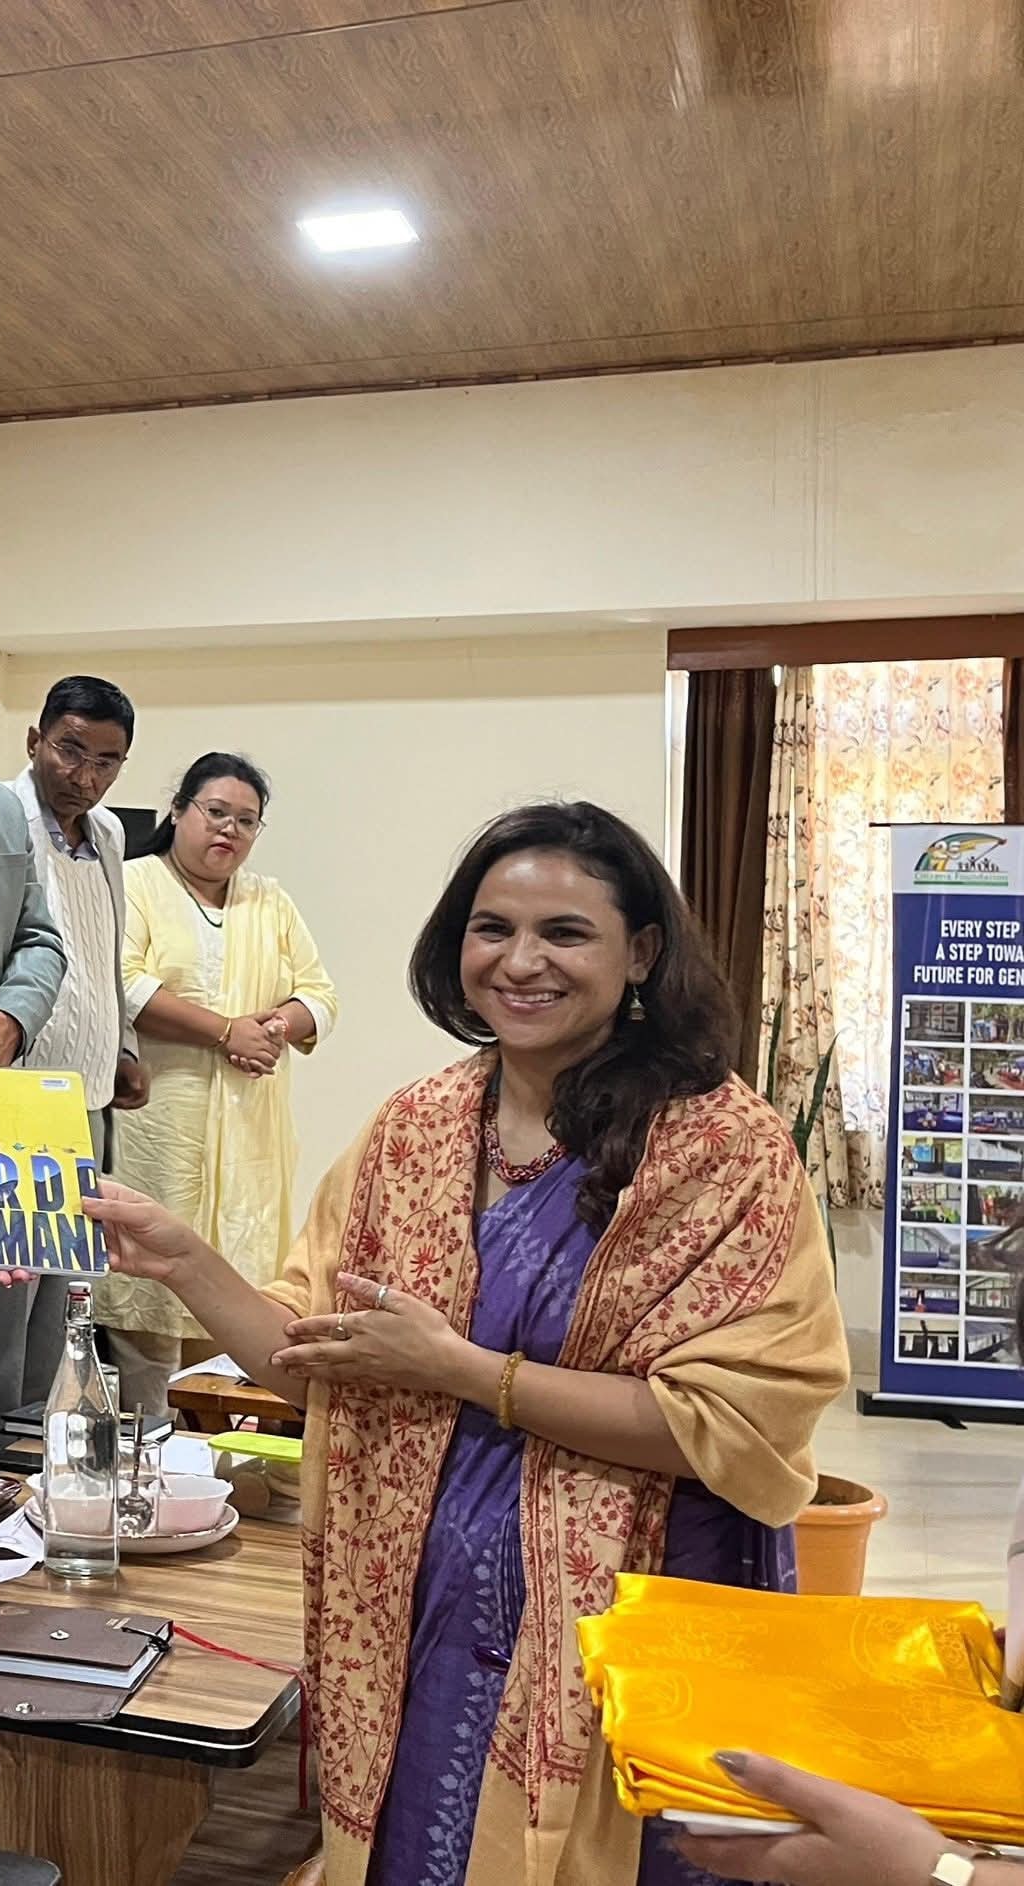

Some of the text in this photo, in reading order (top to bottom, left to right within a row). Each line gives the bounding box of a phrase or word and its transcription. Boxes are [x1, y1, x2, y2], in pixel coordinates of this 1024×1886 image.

[941, 919, 1020, 939] EVERY STEP
[935, 943, 1024, 962] A STEP TOWA
[914, 965, 964, 984] FUTURE
[967, 967, 994, 984] FOR
